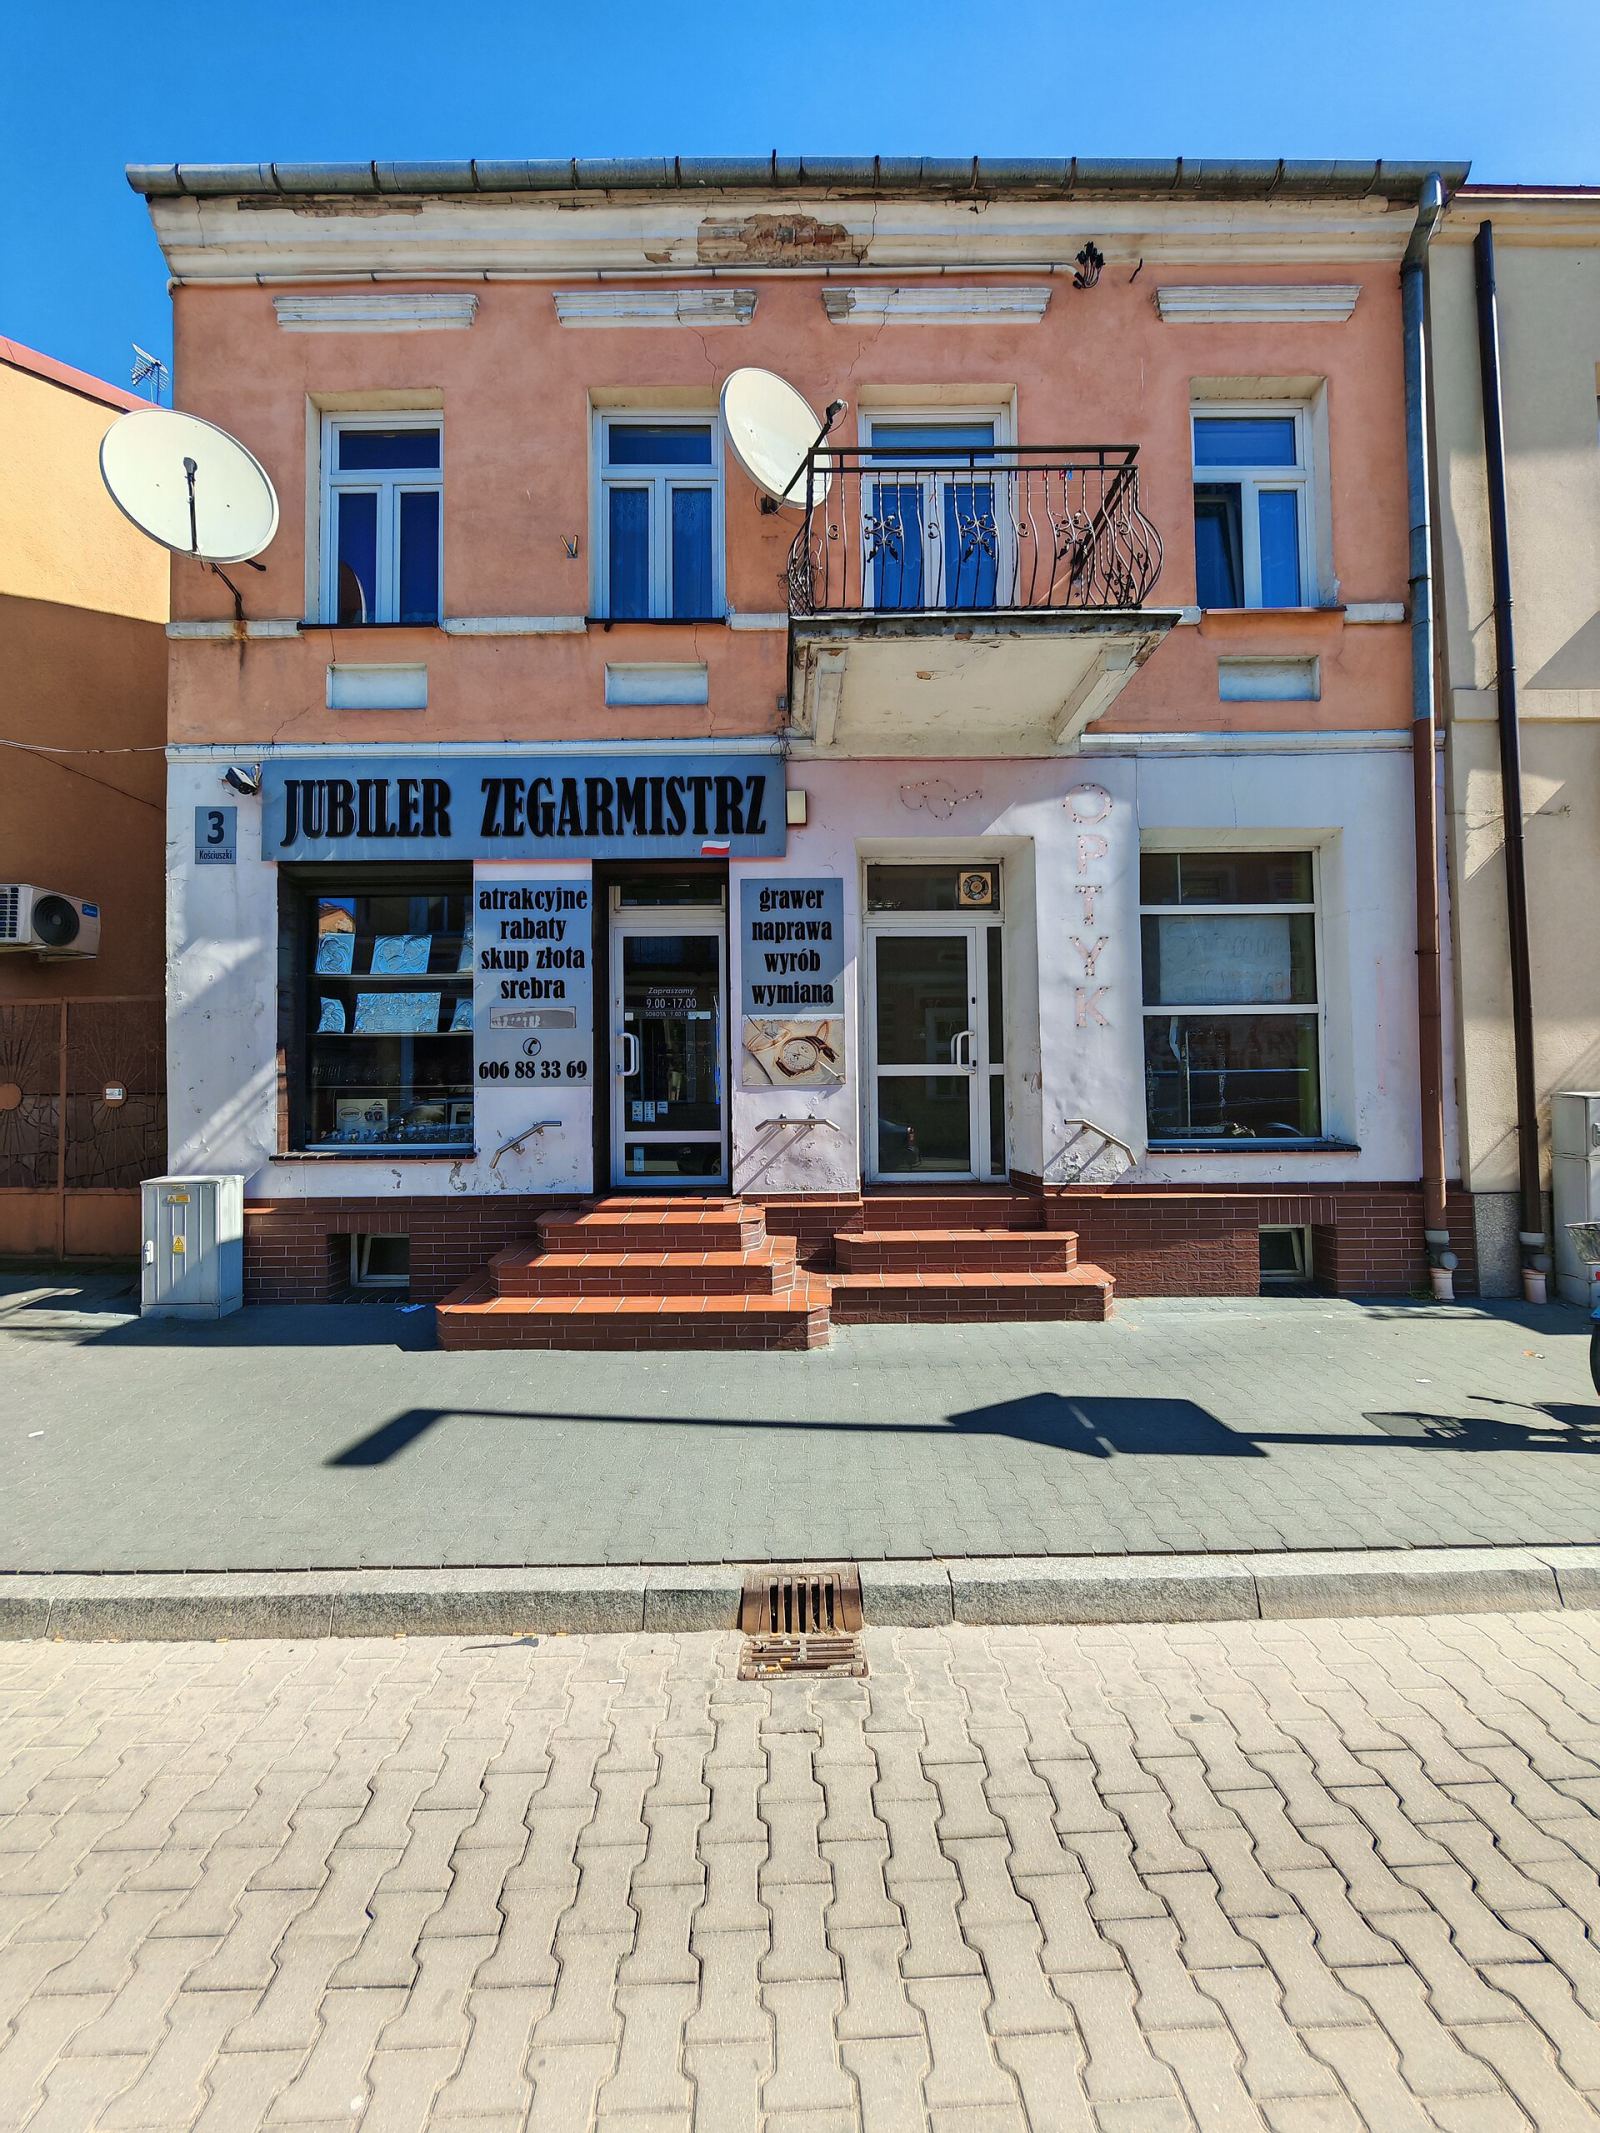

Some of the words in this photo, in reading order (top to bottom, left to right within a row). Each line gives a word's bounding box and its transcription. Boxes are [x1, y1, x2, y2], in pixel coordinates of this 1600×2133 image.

[280, 778, 451, 847] JUBILER
[480, 775, 767, 837] ZEGARMISTRZ
[207, 810, 225, 845] 3
[199, 849, 232, 860] Kościuszki
[479, 887, 588, 912] atrakcyjne
[760, 887, 824, 912] grawer
[1062, 782, 1114, 1028] OPTYK
[500, 917, 567, 941] rabaty
[752, 921, 832, 943] naprawa
[481, 947, 529, 972] skup
[536, 947, 585, 970] złota
[764, 948, 821, 975] wyrób
[501, 977, 566, 999] srebra
[648, 987, 695, 996] Zapraszamy
[752, 981, 834, 1007] wymiana
[479, 1061, 510, 1080] 606
[514, 1061, 536, 1079] 88
[540, 1060, 562, 1079] 33
[566, 1060, 588, 1079] 69
